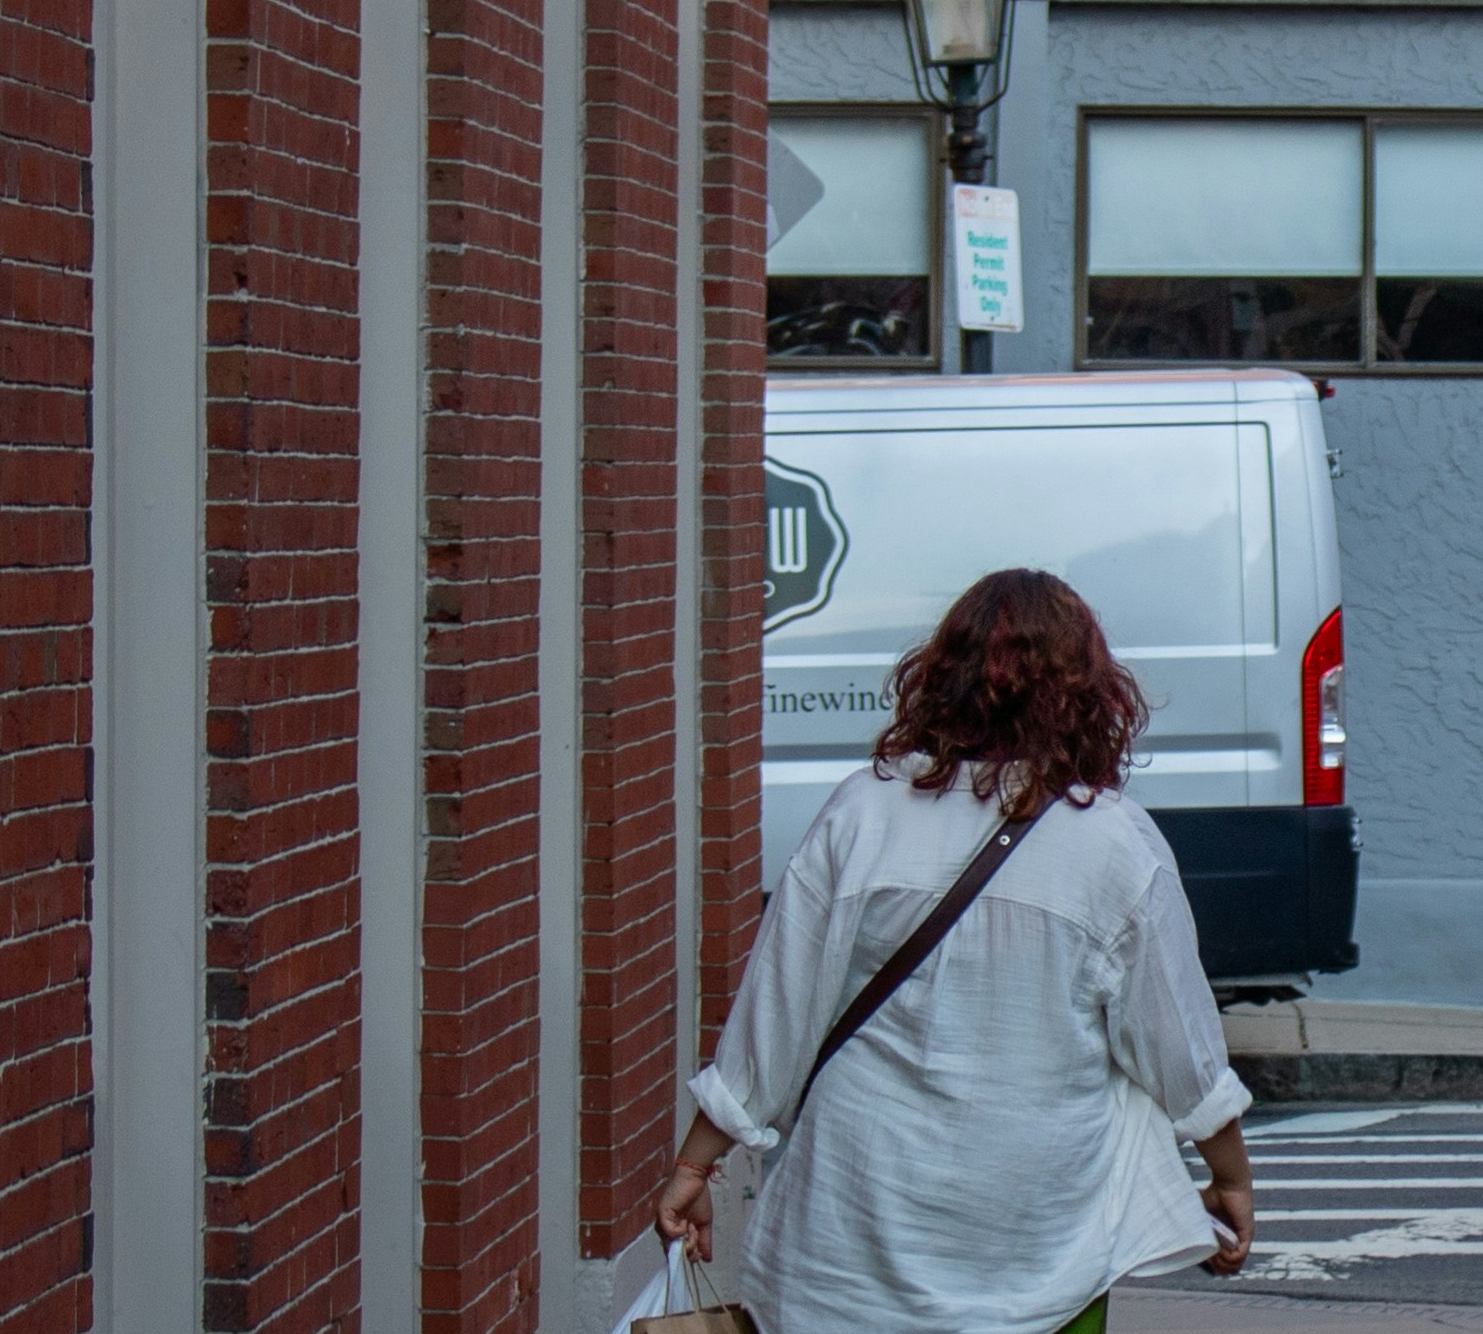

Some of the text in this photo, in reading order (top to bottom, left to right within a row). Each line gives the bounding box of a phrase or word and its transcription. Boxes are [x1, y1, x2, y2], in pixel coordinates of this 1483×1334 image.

[967, 231, 1008, 249] Resident
[974, 253, 1005, 270] Permit
[972, 274, 1008, 296] Parking
[980, 296, 1002, 316] Only
